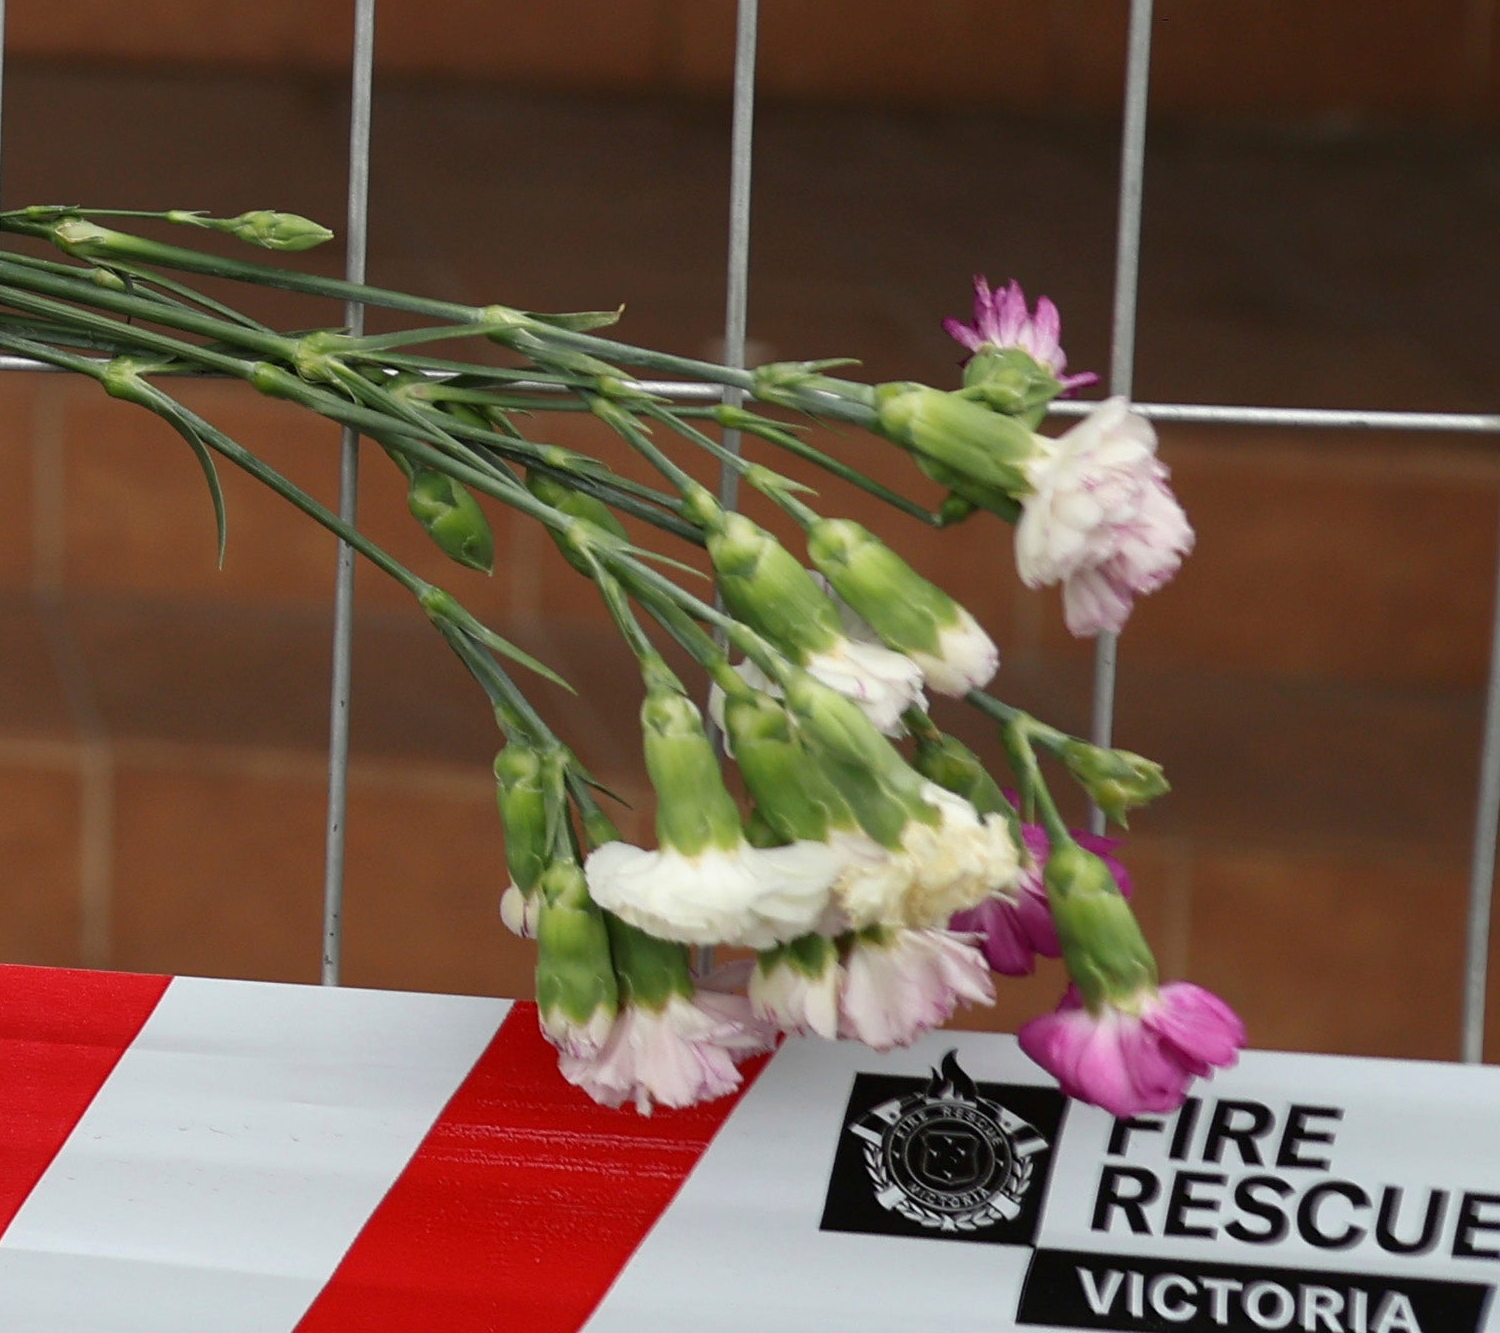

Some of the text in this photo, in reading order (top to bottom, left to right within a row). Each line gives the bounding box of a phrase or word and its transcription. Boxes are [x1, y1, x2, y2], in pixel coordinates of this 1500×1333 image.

[1106, 1097, 1345, 1172] FIRE
[1090, 1164, 1500, 1261] RESCUE
[1075, 1266, 1424, 1333] VICTORIA
